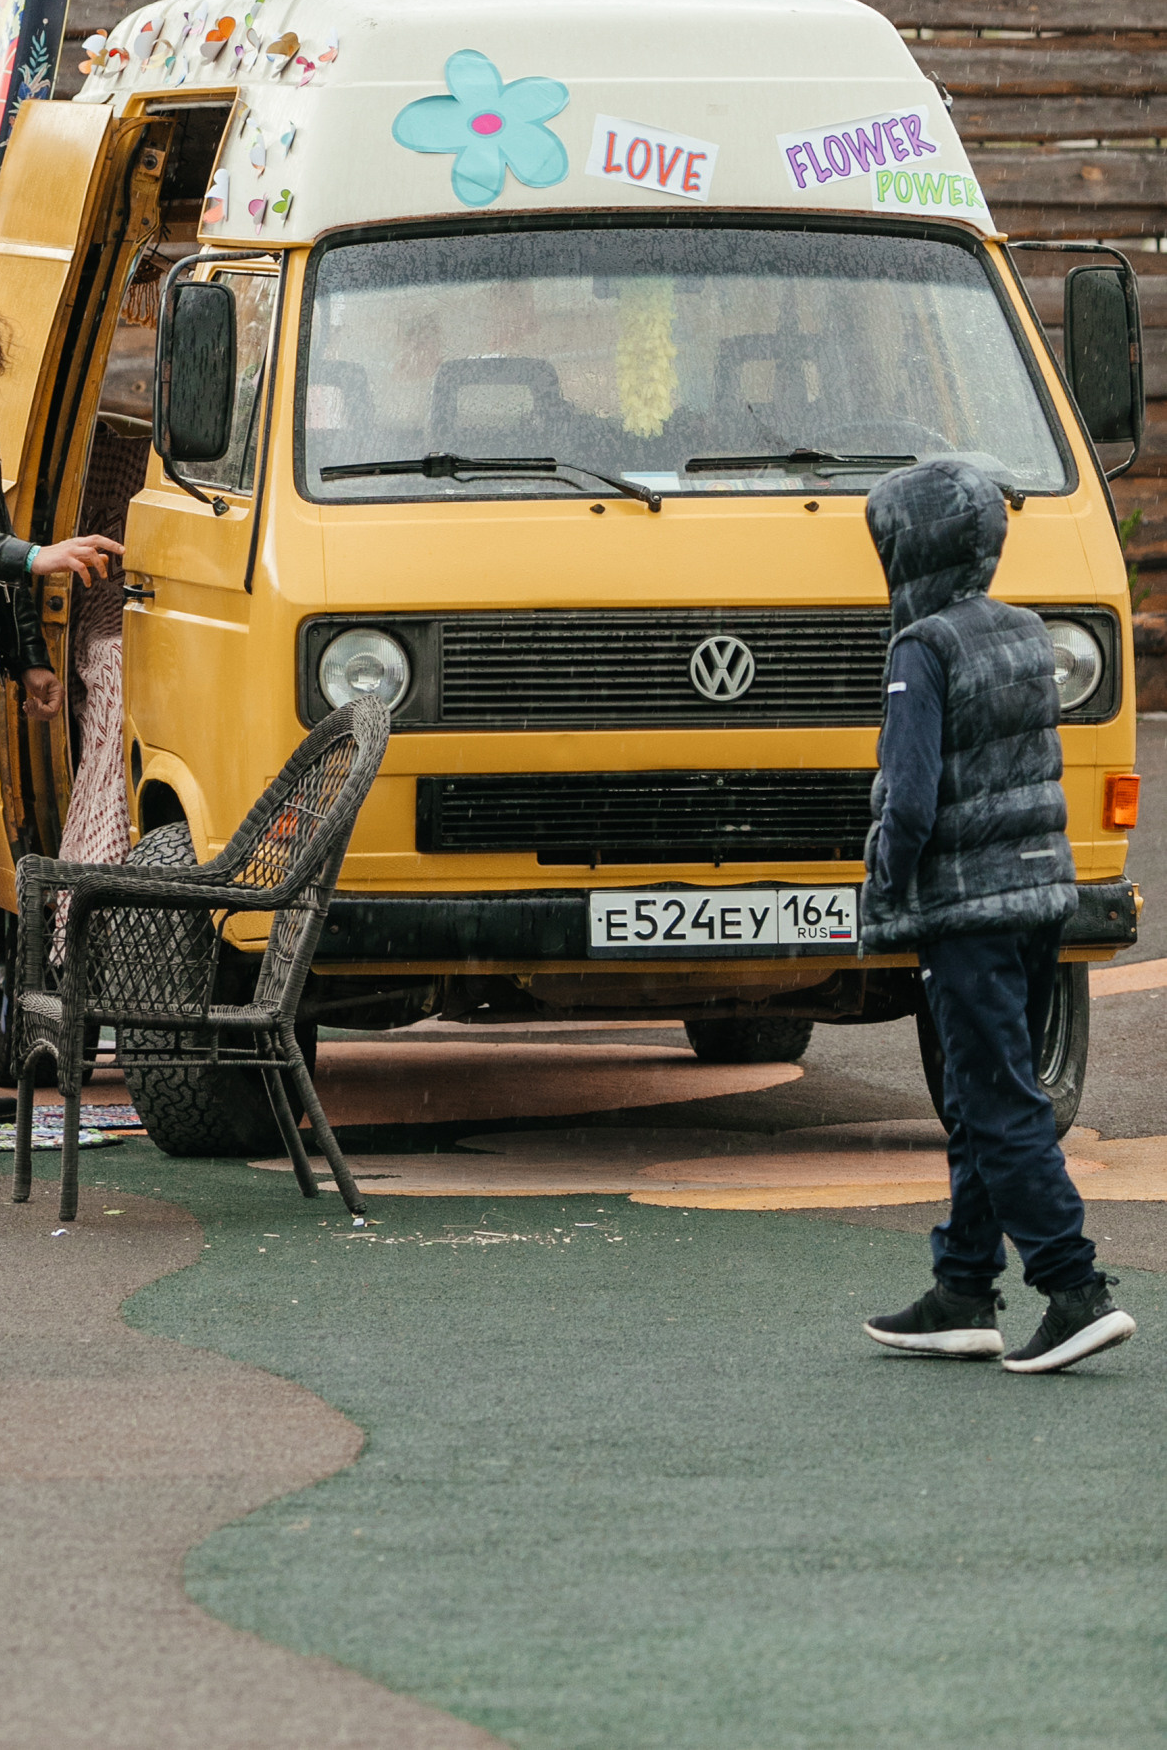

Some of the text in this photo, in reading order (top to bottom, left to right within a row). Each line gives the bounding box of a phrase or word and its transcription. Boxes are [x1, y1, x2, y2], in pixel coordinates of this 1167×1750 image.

[603, 131, 707, 193] LOVE
[785, 113, 937, 189] FLOWER
[876, 169, 985, 209] POWER
[605, 894, 844, 942] Е524ЕУ 164
[798, 927, 828, 939] RUS
